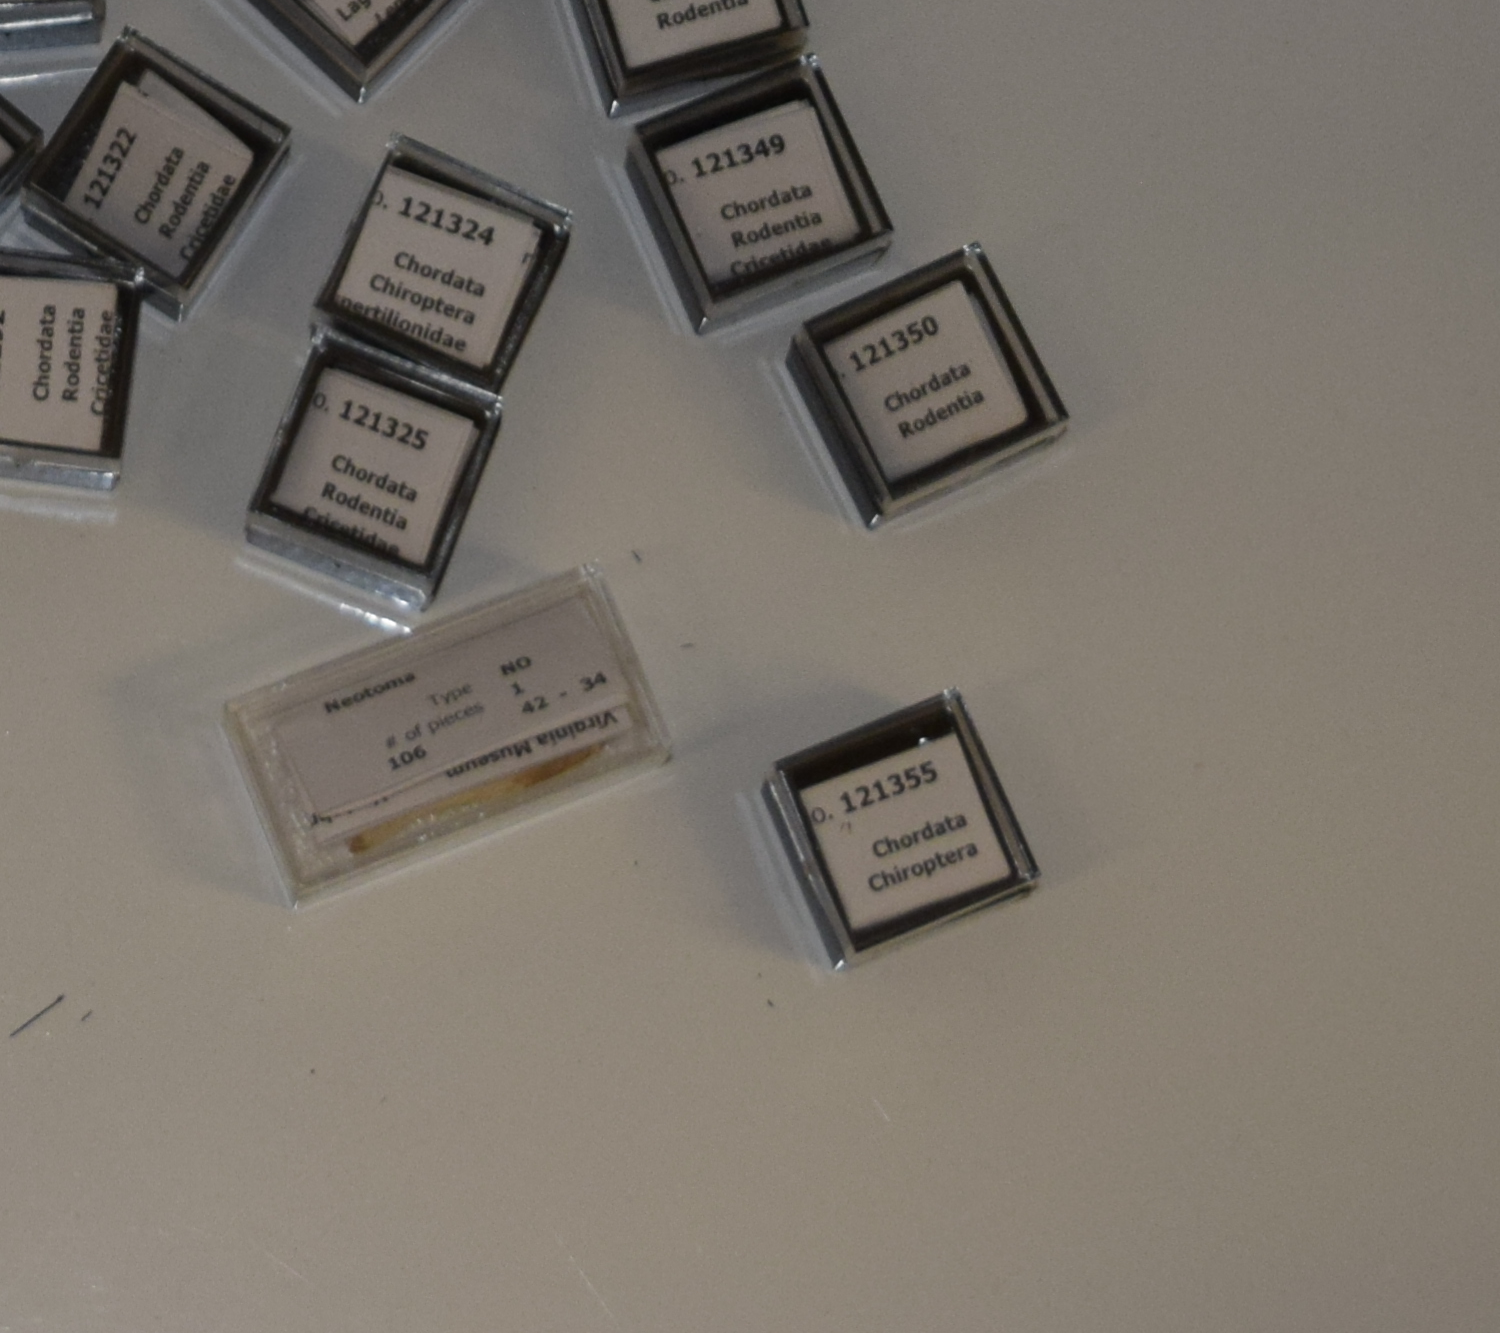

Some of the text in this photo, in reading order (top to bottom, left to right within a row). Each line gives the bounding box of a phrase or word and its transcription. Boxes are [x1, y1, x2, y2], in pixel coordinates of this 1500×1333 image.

[83, 127, 137, 210] 121322
[691, 134, 785, 178] 121349
[399, 197, 495, 246] 121324
[720, 186, 813, 221] Chordata
[850, 316, 938, 372] 121350
[884, 364, 971, 413] Chordata
[339, 400, 429, 450] 121325
[898, 391, 985, 439] Rodentia
[840, 761, 937, 814] 121355
[872, 815, 967, 858] Chordata
[868, 843, 978, 892] Chiroptera
